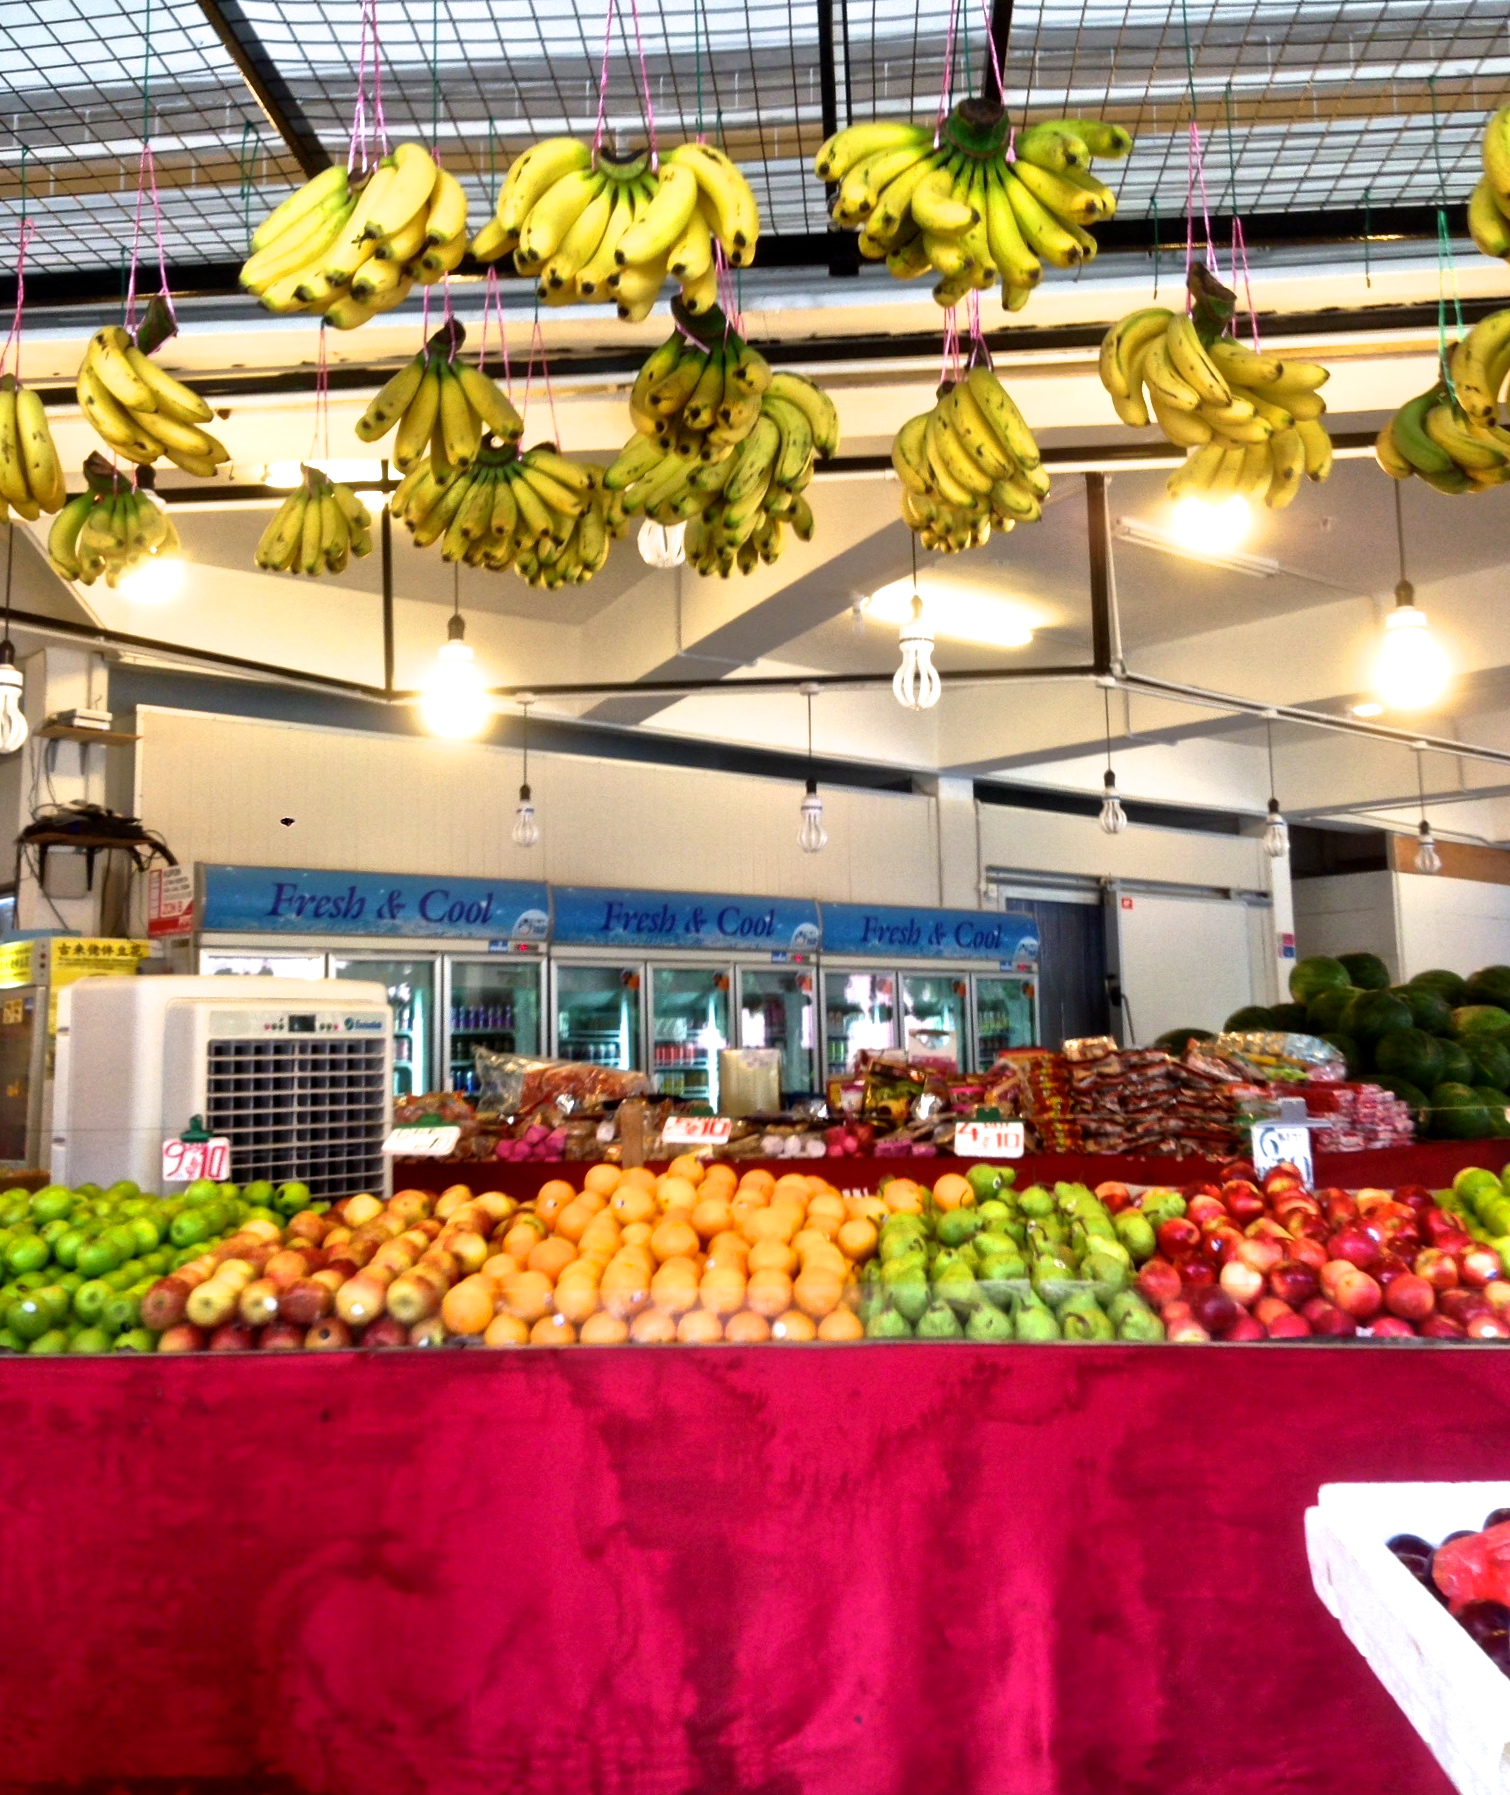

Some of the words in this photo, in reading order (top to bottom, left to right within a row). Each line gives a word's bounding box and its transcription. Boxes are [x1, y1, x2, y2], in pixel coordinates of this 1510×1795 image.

[266, 882, 367, 920] Fresh
[377, 889, 406, 920] &
[418, 889, 494, 924] Cool
[602, 901, 677, 933] Fresh
[684, 906, 708, 934] &
[717, 905, 775, 937] Cool
[861, 915, 921, 945] Fresh
[928, 921, 947, 945] &
[954, 921, 1002, 949] Cool
[958, 1122, 978, 1142] 4
[996, 1132, 1020, 1148] 10
[1259, 1127, 1286, 1163] 6
[165, 1141, 186, 1177] 9
[200, 1144, 227, 1178] 10
